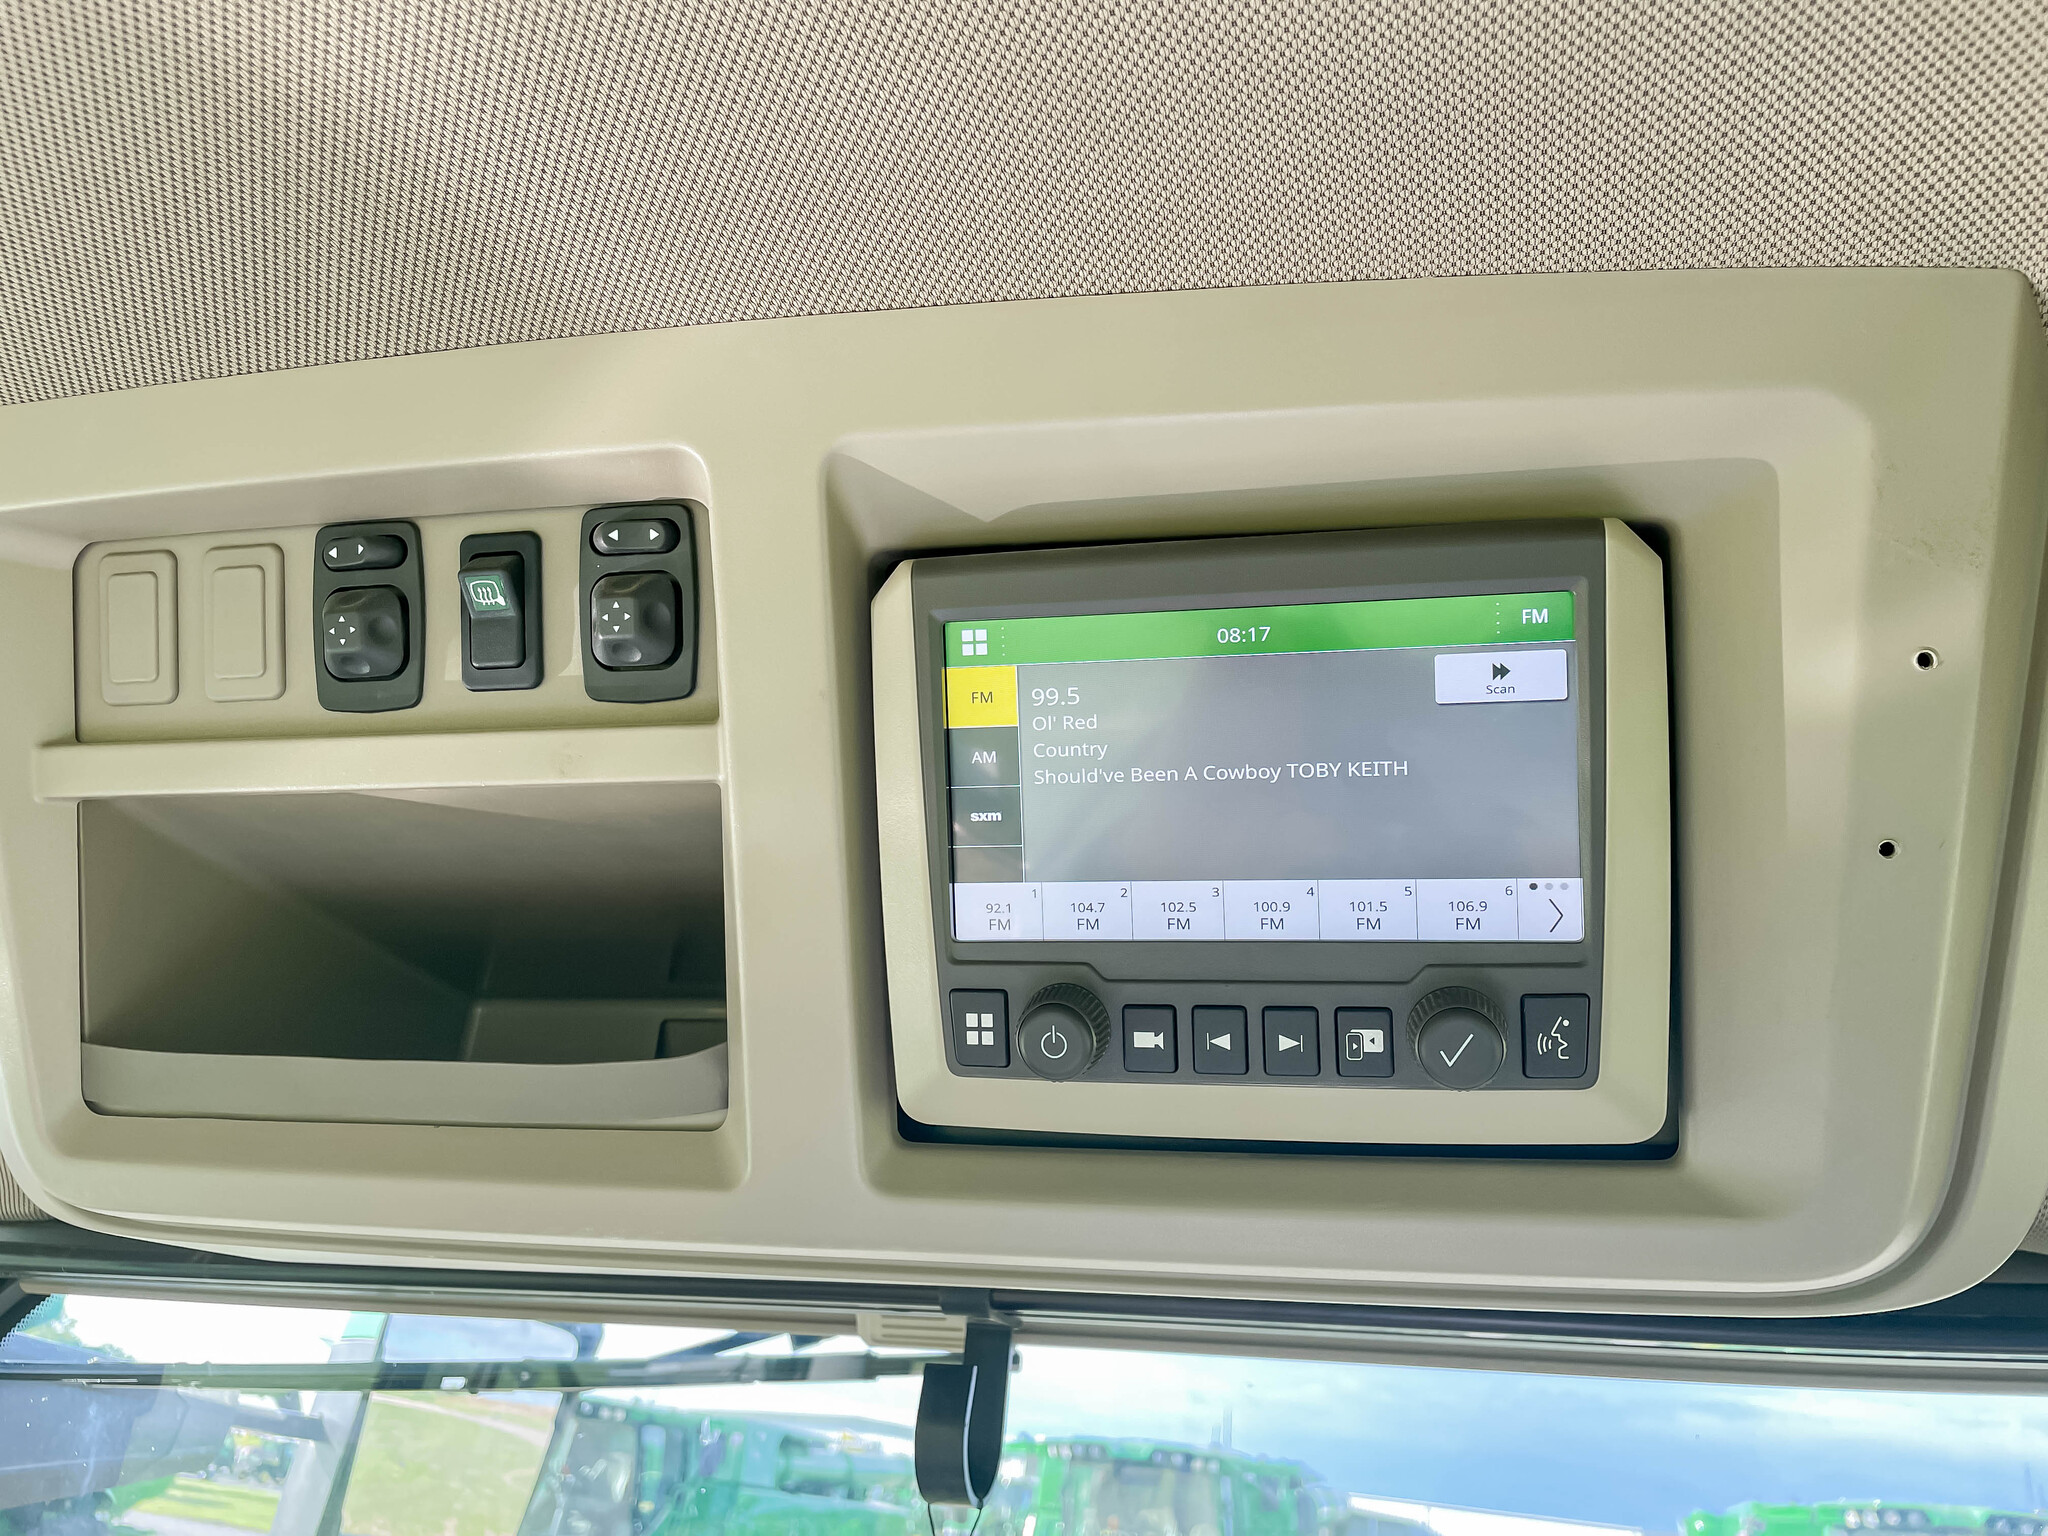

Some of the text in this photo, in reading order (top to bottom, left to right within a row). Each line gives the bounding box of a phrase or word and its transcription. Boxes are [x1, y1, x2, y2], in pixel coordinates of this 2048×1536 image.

[1522, 608, 1549, 625] FM
[1217, 626, 1271, 644] 08:17
[1485, 683, 1516, 695] Scan
[971, 691, 994, 704] FM
[1031, 687, 1080, 707] 99.5
[1032, 714, 1098, 731] Ol' Red
[971, 751, 997, 764] AM
[1033, 743, 1108, 760] Country
[1034, 761, 1408, 785] Should've Been A Cowboy TOBY KEITH
[970, 811, 1002, 822] sxm
[1031, 888, 1038, 899] 1
[1120, 887, 1128, 899] 2
[1211, 887, 1220, 898] 3
[1306, 886, 1315, 897] 4
[1404, 886, 1413, 897] 5
[1504, 886, 1514, 897] 6
[985, 903, 1012, 914] 92.1
[1070, 902, 1105, 913] 104.7
[1160, 901, 1197, 913] 102.5
[1253, 901, 1291, 913] 100.9
[1349, 901, 1388, 912] 101.5
[1448, 901, 1488, 912] 106.9
[988, 919, 1011, 931] FM
[1076, 918, 1100, 931] FM
[1167, 918, 1191, 930] FM
[1260, 917, 1285, 930] FM
[1356, 917, 1381, 930] FM
[1455, 917, 1481, 930] FM
